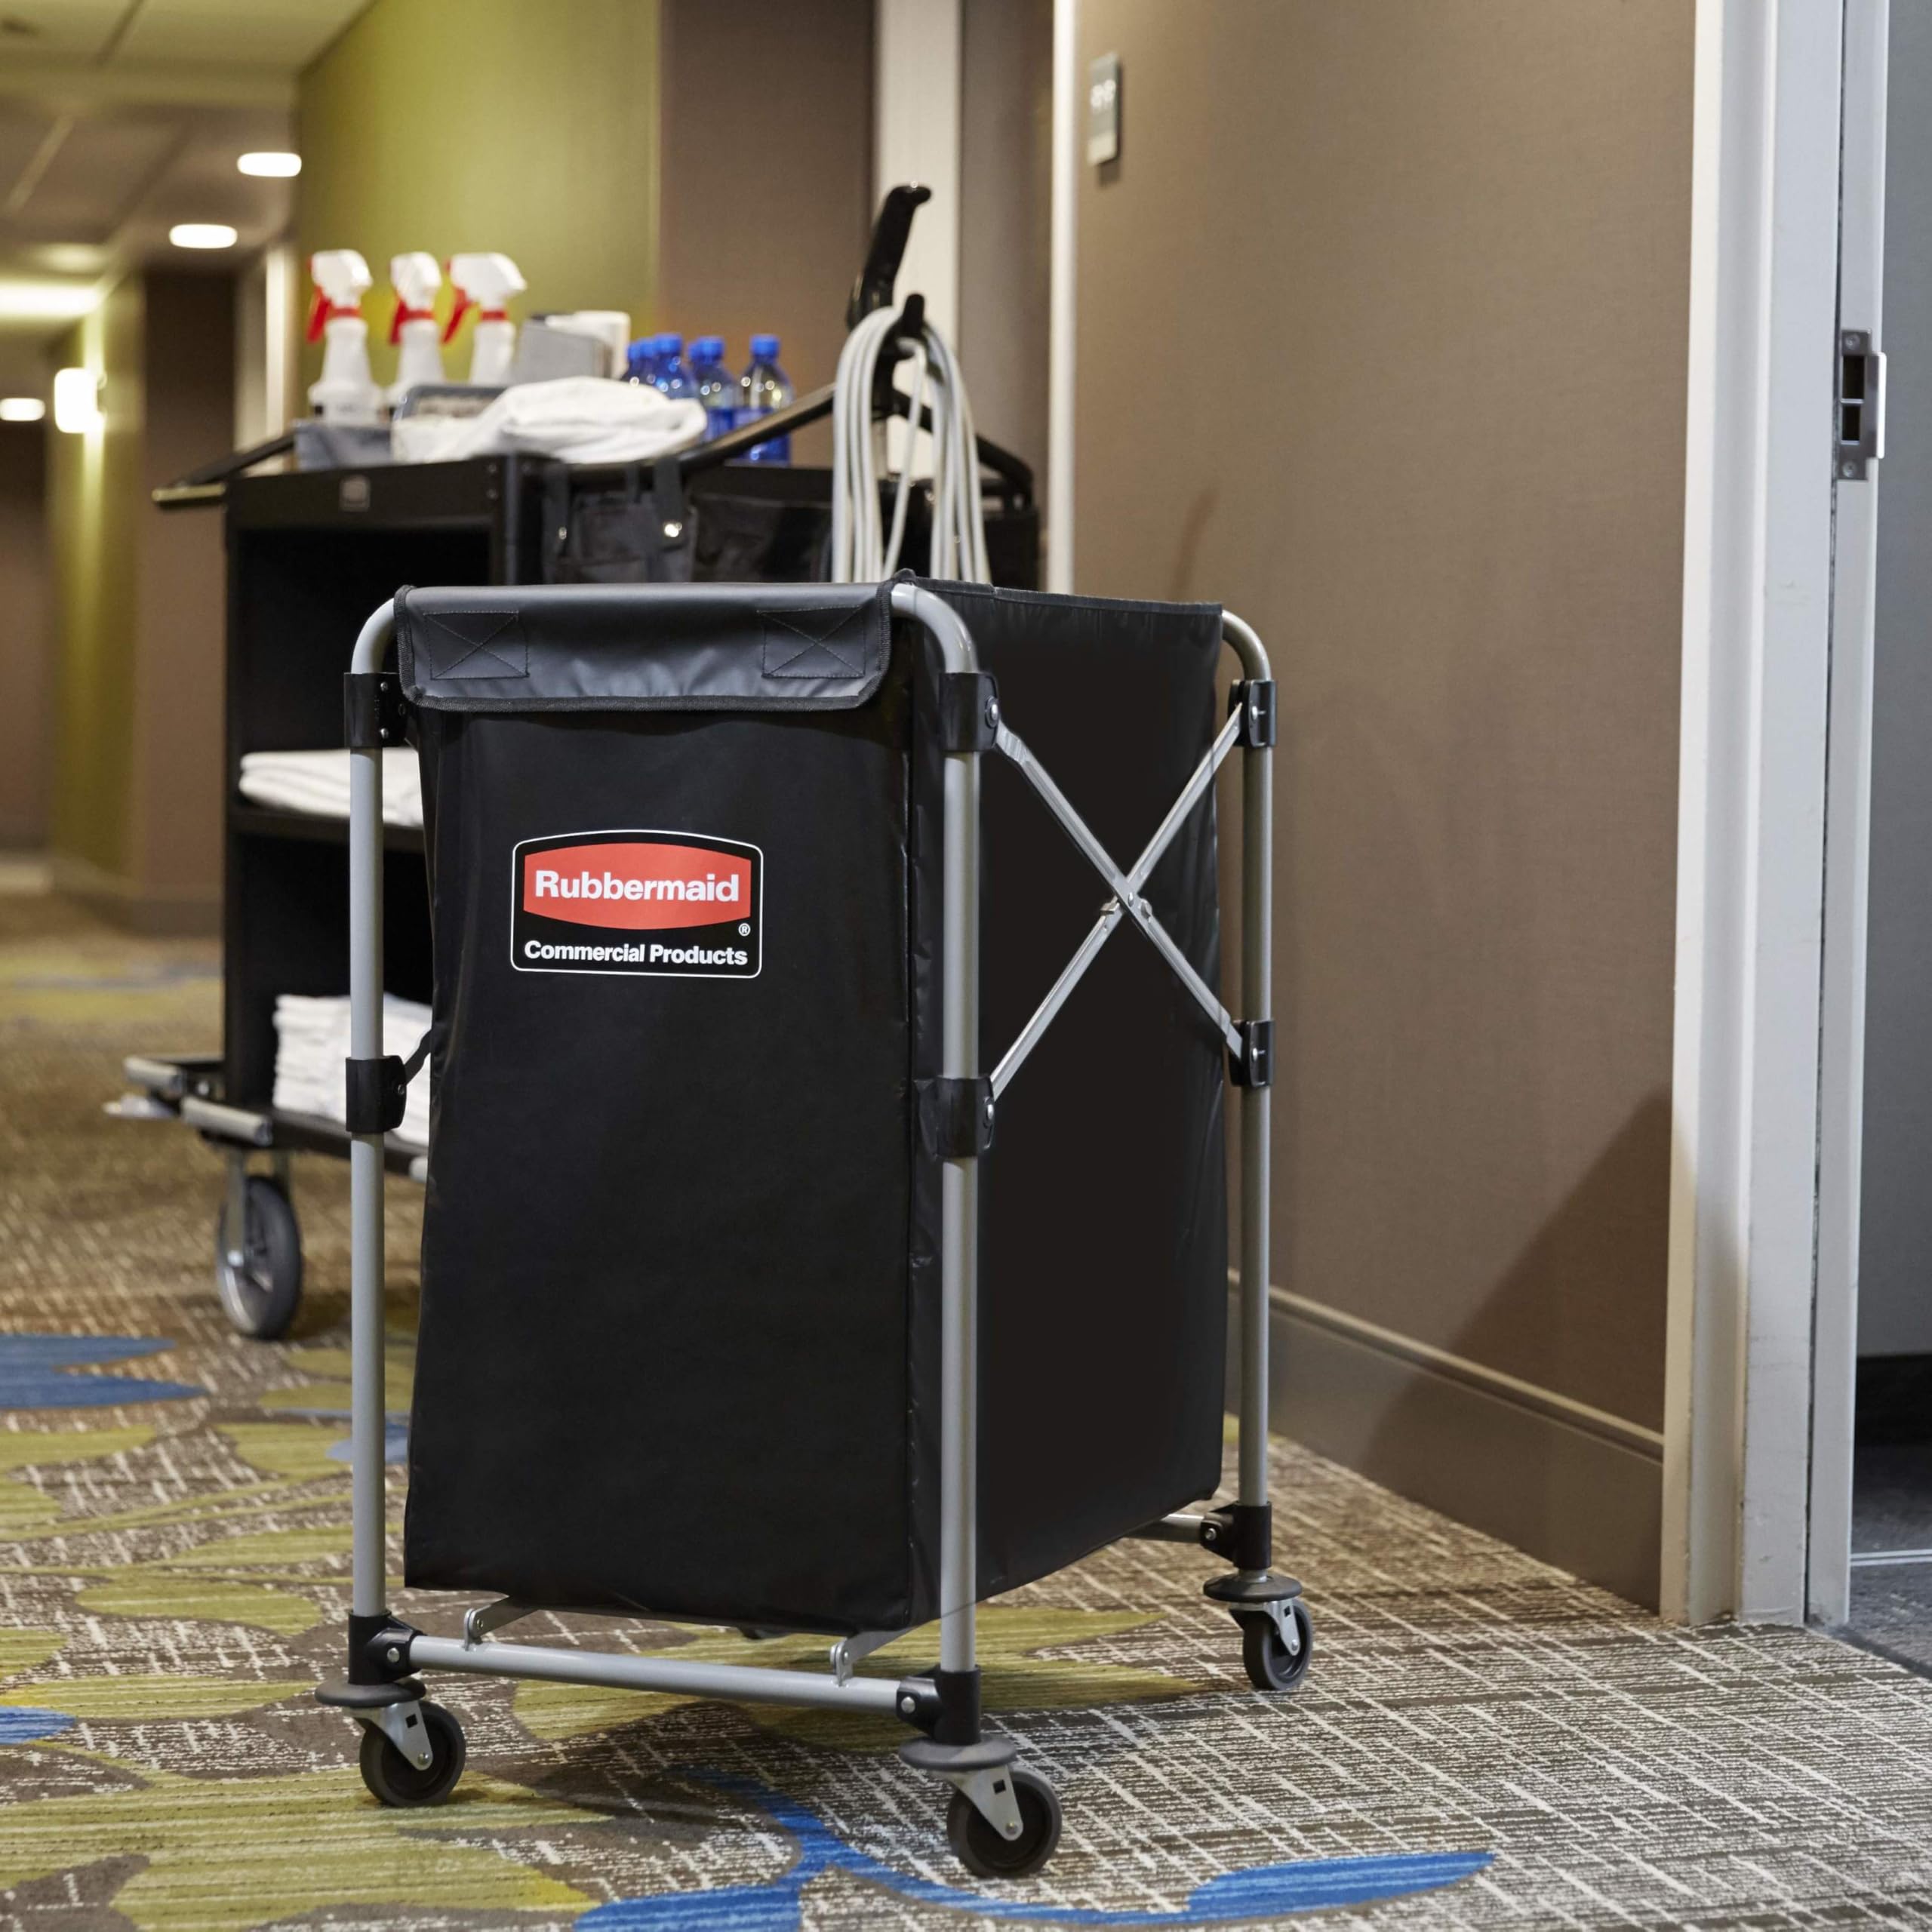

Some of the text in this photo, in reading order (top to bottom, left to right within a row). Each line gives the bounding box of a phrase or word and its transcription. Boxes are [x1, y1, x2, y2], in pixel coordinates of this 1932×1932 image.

[535, 869, 739, 902] Rubbermaid
[525, 940, 748, 966] Commercial Products
